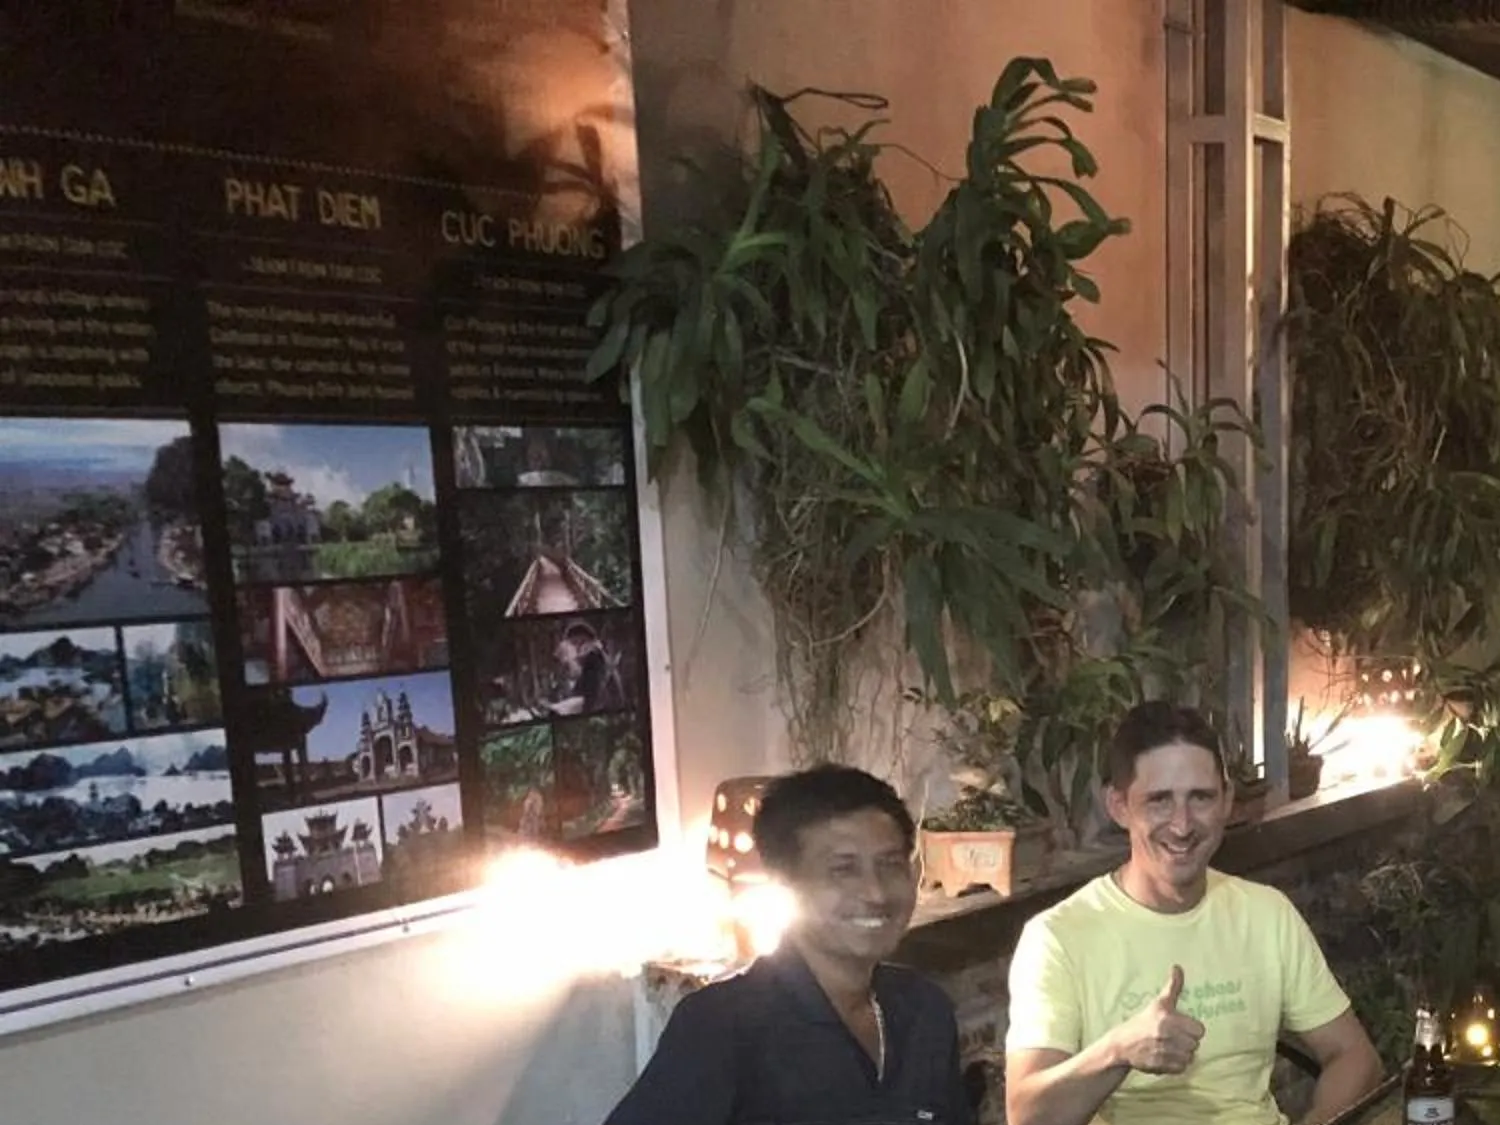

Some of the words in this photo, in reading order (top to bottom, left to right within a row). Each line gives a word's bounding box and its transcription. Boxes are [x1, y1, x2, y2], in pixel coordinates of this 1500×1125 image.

[60, 164, 117, 207] GA
[225, 178, 301, 222] PHAT
[318, 190, 382, 230] DIEM
[441, 210, 497, 248] CUC
